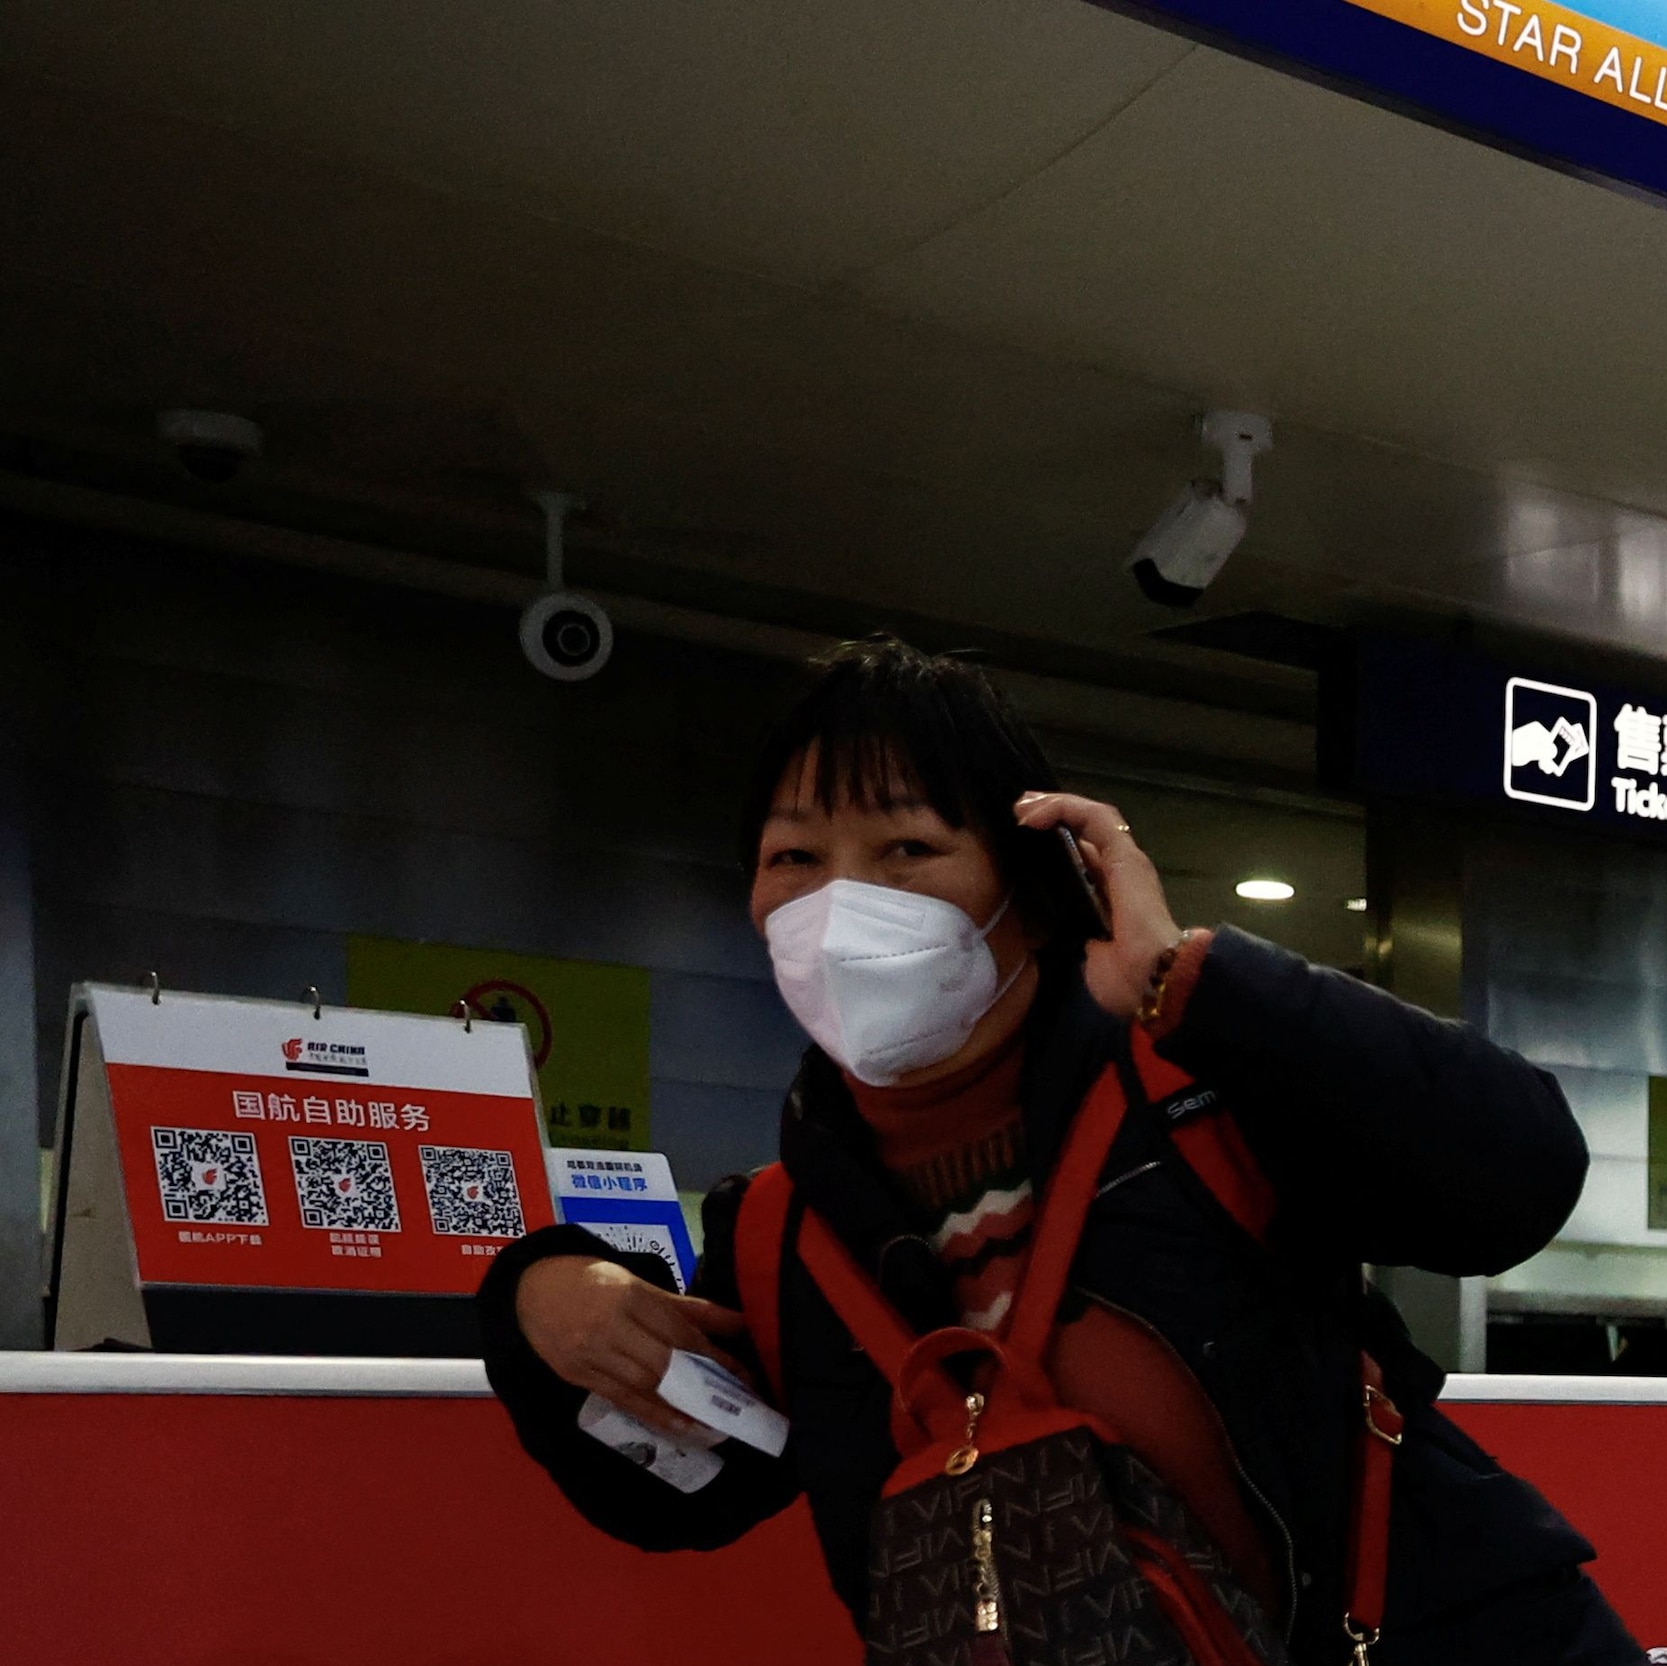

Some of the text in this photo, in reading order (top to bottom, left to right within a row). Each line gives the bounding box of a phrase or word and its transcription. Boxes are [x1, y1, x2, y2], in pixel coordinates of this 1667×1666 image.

[1457, 0, 1583, 73] STAR
[307, 1042, 365, 1055] AIR CHINA
[232, 1090, 431, 1133] 国航自助服务
[572, 1175, 647, 1191] 微信小程序
